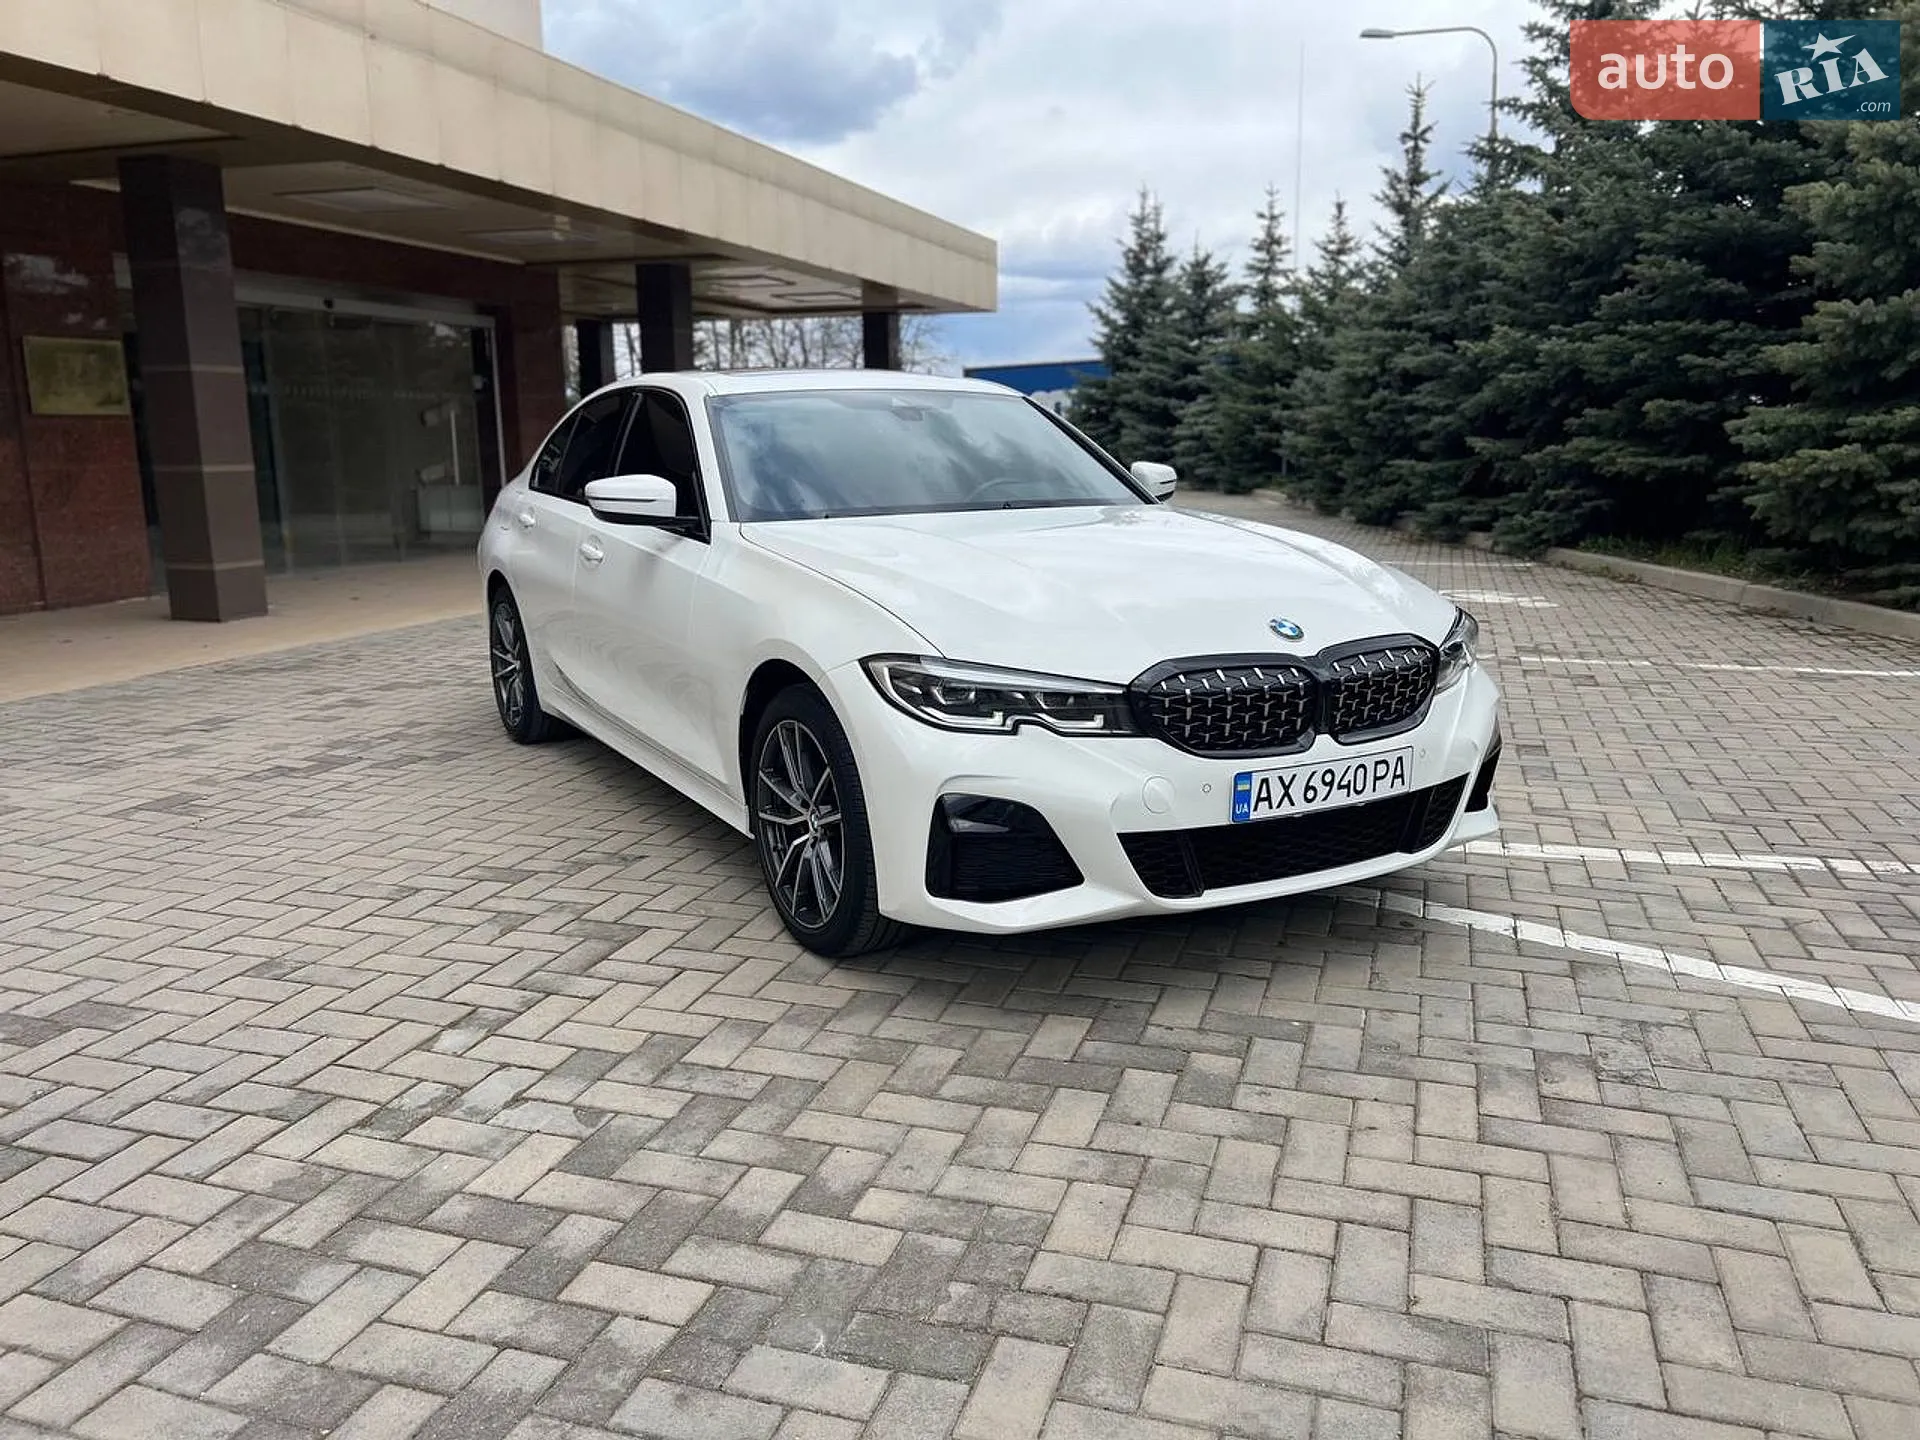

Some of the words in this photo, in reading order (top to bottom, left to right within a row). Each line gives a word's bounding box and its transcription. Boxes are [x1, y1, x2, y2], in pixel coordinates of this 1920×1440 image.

[1252, 773, 1298, 812] AX
[1303, 763, 1368, 804] 6940
[1372, 756, 1406, 793] PA
[1235, 803, 1249, 814] UA
